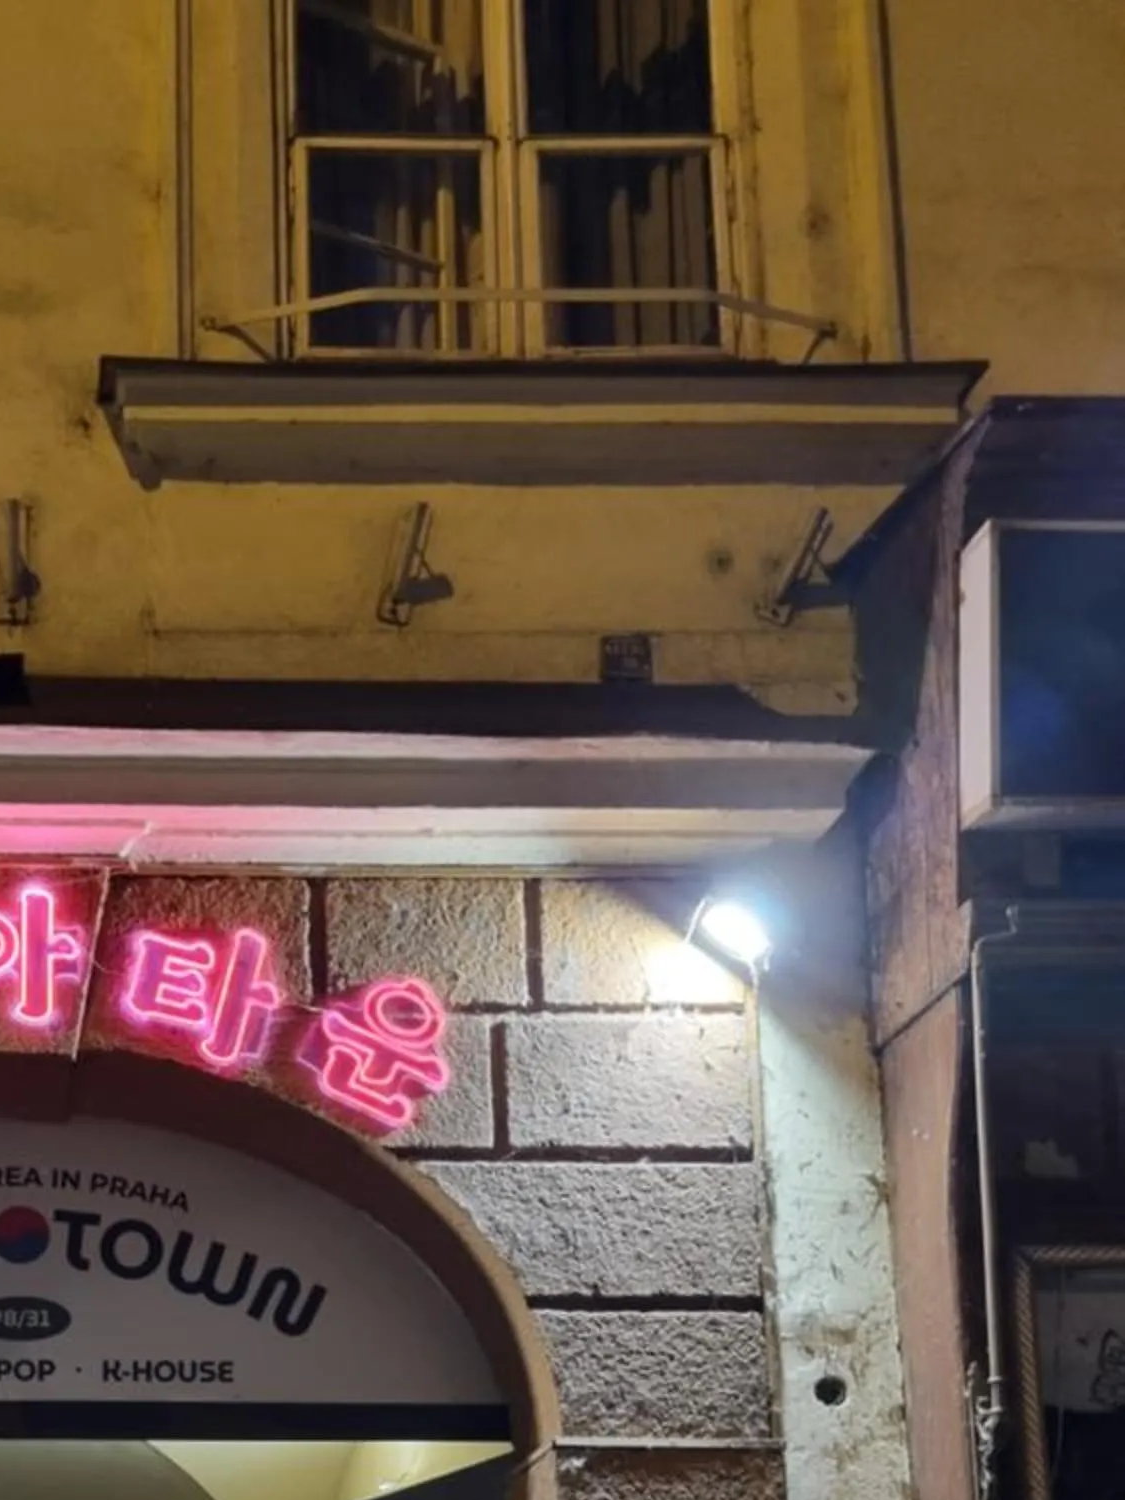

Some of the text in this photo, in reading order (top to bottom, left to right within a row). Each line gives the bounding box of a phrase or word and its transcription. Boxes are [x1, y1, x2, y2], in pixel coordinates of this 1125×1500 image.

[51, 1168, 81, 1191] IN
[90, 1172, 190, 1212] PRAHA
[53, 1208, 328, 1337] TOWN
[101, 1359, 235, 1384] K-HOUSE
